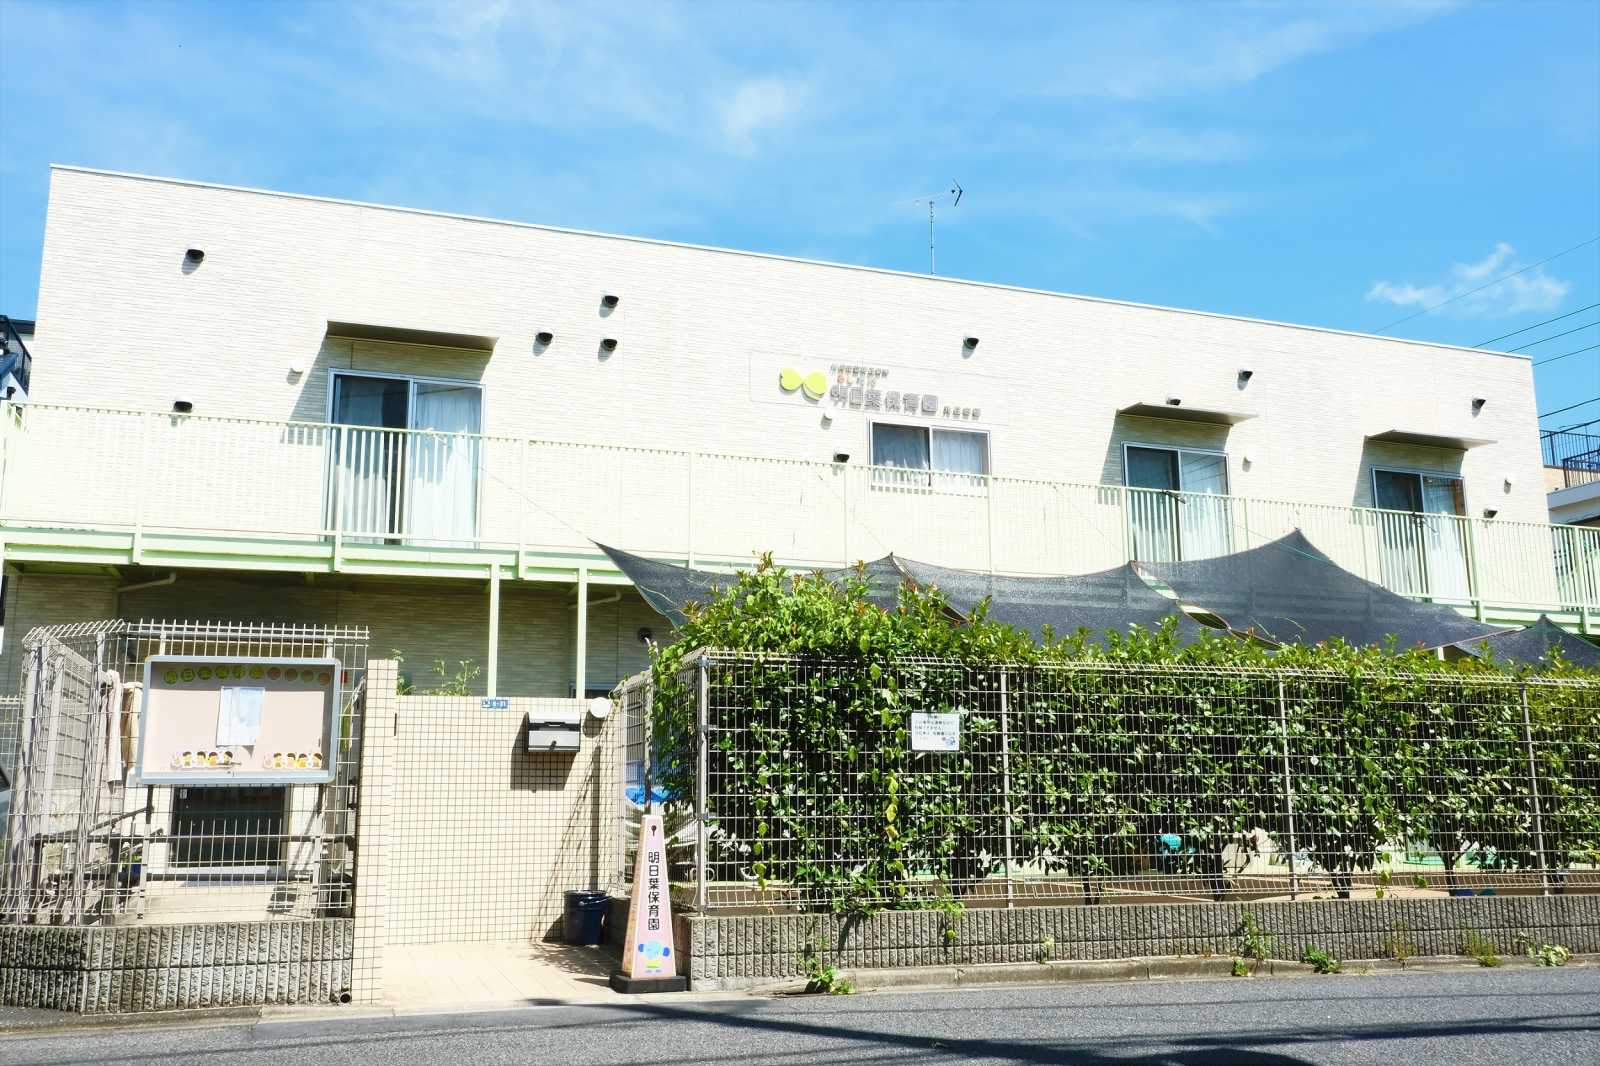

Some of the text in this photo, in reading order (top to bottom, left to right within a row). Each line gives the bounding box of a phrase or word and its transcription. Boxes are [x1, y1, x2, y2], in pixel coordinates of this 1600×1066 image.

[648, 851, 660, 931] 明日葉保育園
